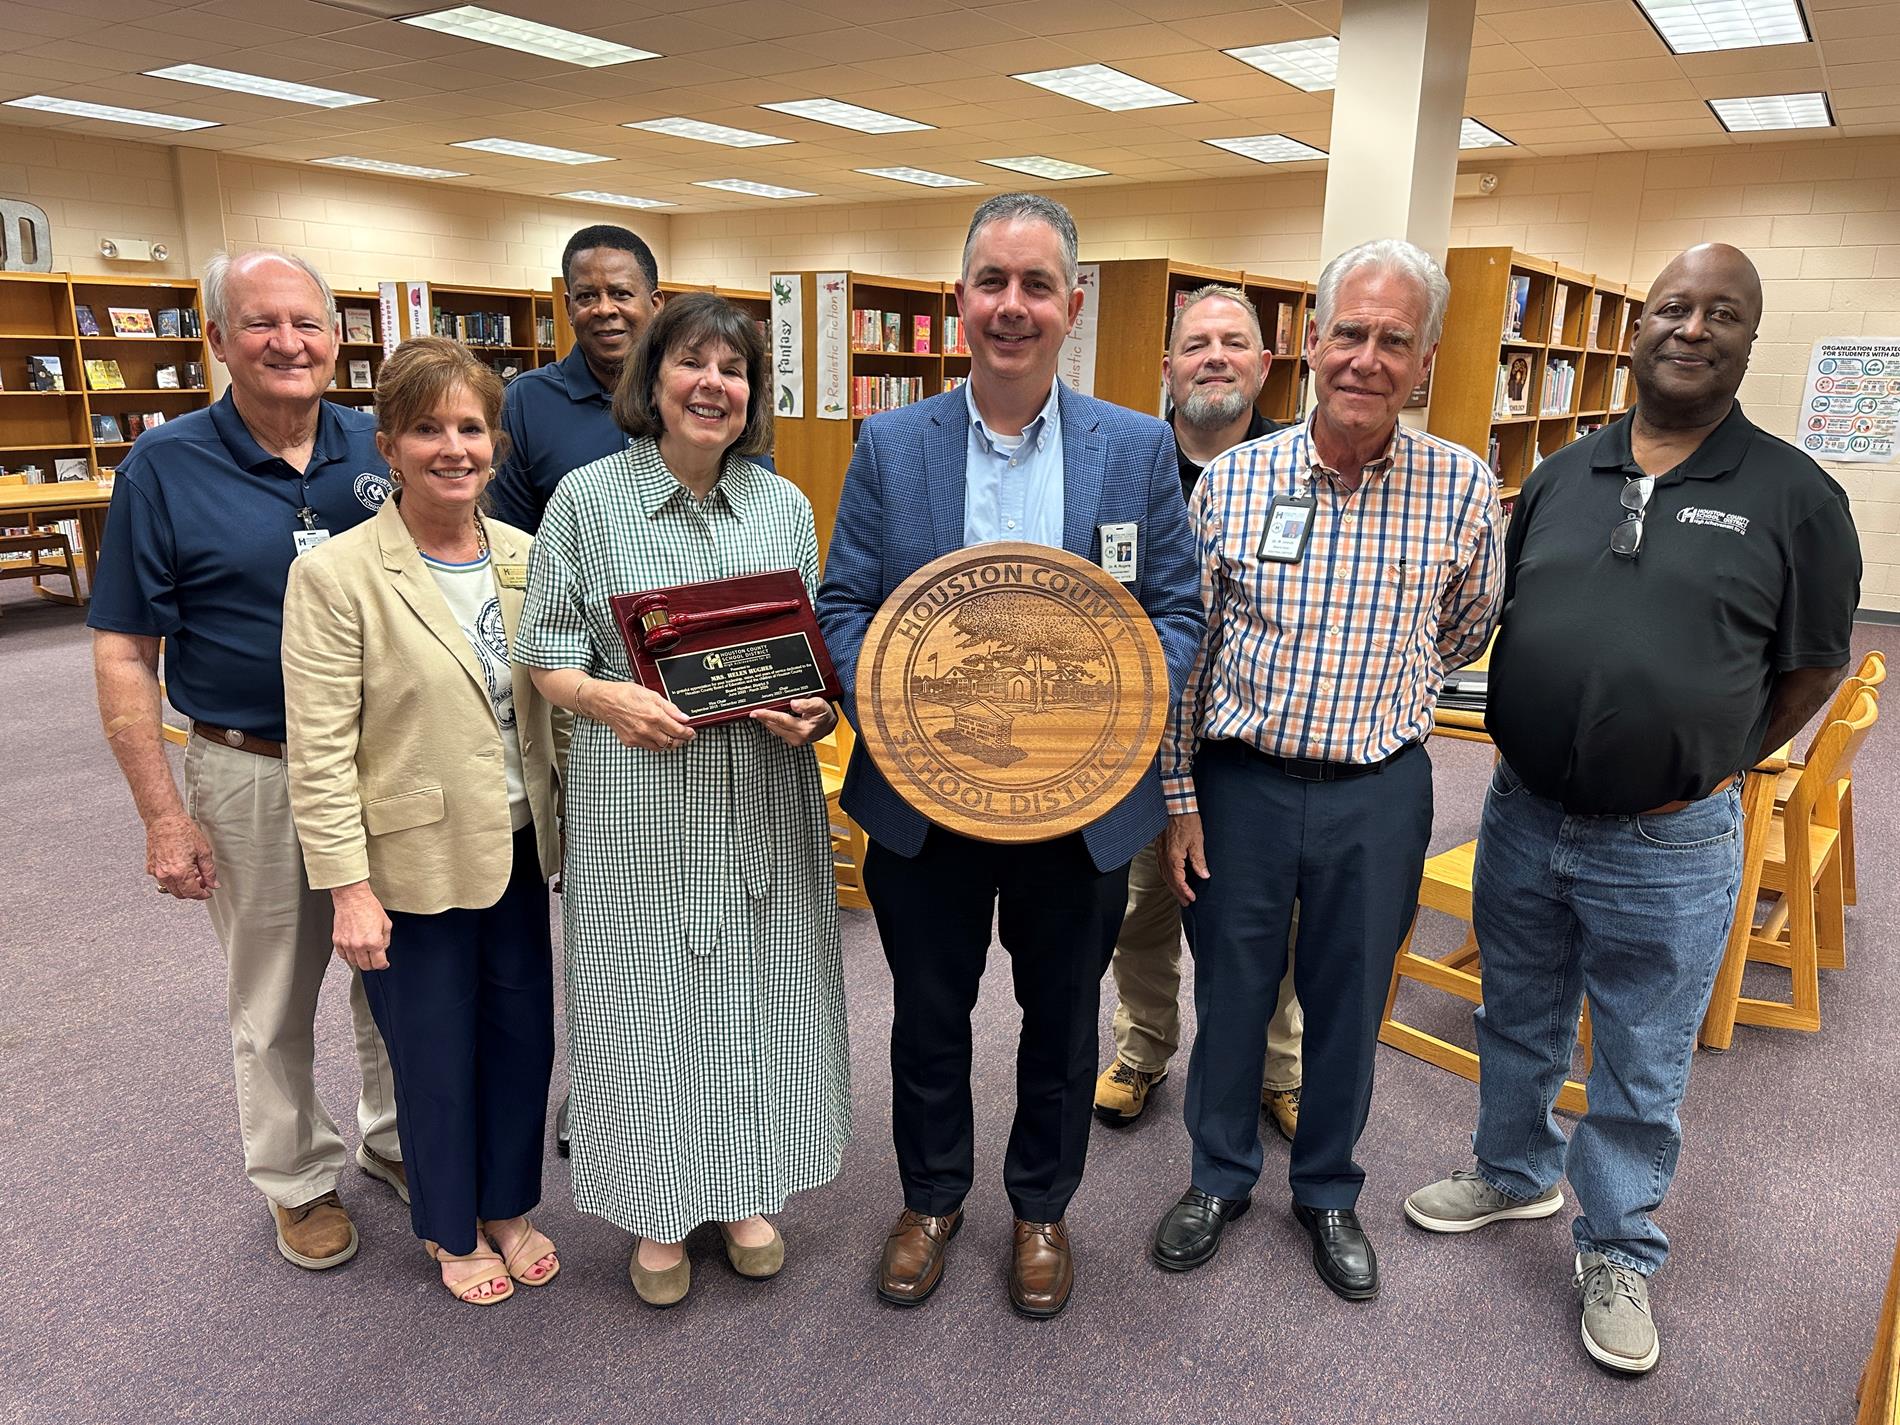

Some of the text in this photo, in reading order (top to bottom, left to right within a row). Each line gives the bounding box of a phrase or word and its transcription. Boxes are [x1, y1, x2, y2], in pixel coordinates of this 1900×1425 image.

[826, 296, 839, 398] Realistic Fiction
[1066, 346, 1081, 393] ealistic
[1697, 508, 1726, 518] HOUSTON
[897, 564, 1131, 646] HOUSTON COUNTY
[894, 730, 1131, 816] SCHOOL DISTRICT
